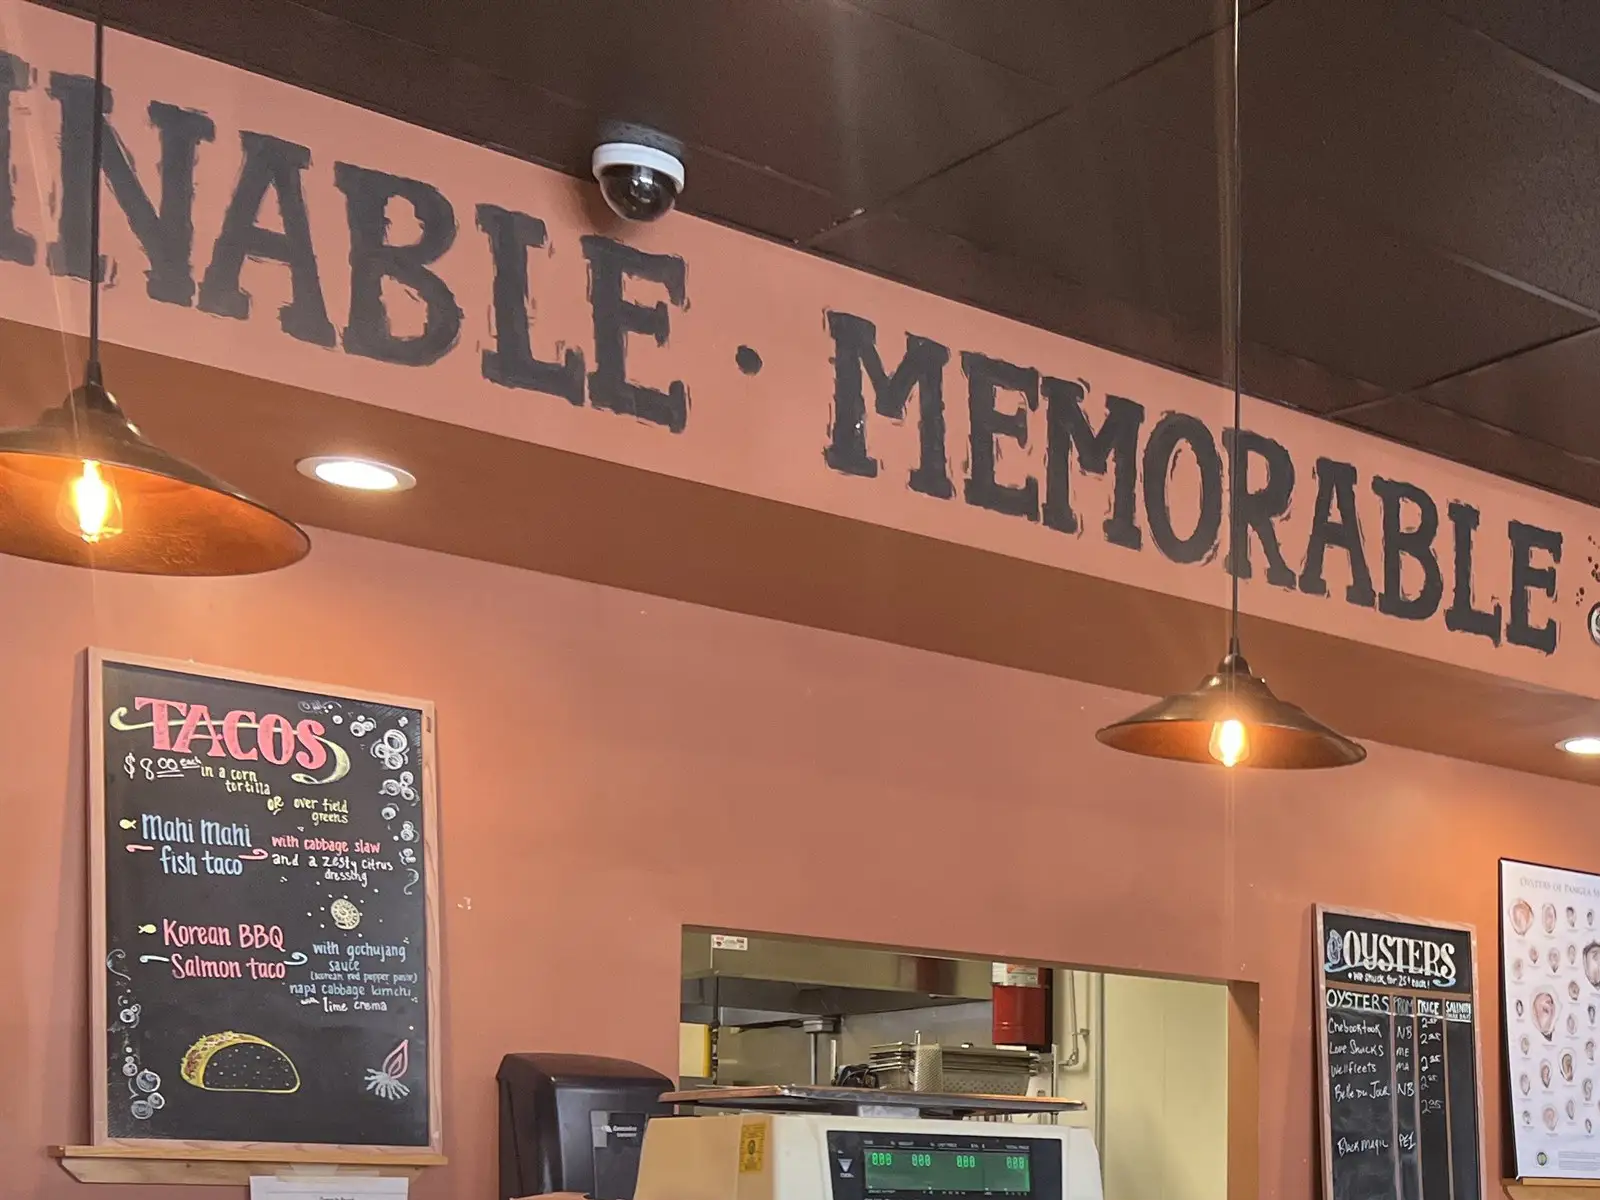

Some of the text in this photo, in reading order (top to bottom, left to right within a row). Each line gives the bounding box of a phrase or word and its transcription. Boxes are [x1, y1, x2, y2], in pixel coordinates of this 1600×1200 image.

[822, 306, 1563, 654] MEMORABLE
[135, 697, 327, 769] TACOS
[201, 766, 257, 782] in a corn
[225, 780, 271, 795] tortilla
[294, 798, 318, 809] over
[322, 799, 348, 814] field
[312, 813, 348, 826] greens
[142, 814, 252, 847] Mahi Mahi
[272, 836, 381, 856] with cabbage slaw
[160, 845, 243, 875] fish taco
[272, 854, 393, 875] and a zesty citrus
[325, 868, 367, 887] dressing
[163, 918, 285, 952] Korean BBQ
[312, 941, 406, 962] with gochujang
[1343, 930, 1456, 980] OYSTERS
[171, 953, 286, 980] Salmon taco
[329, 960, 360, 972] sauce
[289, 983, 411, 1000] napa cabbage kimchi
[322, 997, 348, 1012] lime
[353, 1001, 387, 1011] crema
[1327, 989, 1389, 1014] OYSTERS
[1417, 999, 1440, 1015] PRICE
[1396, 1026, 1412, 1040] NB
[1397, 1082, 1415, 1097] NB
